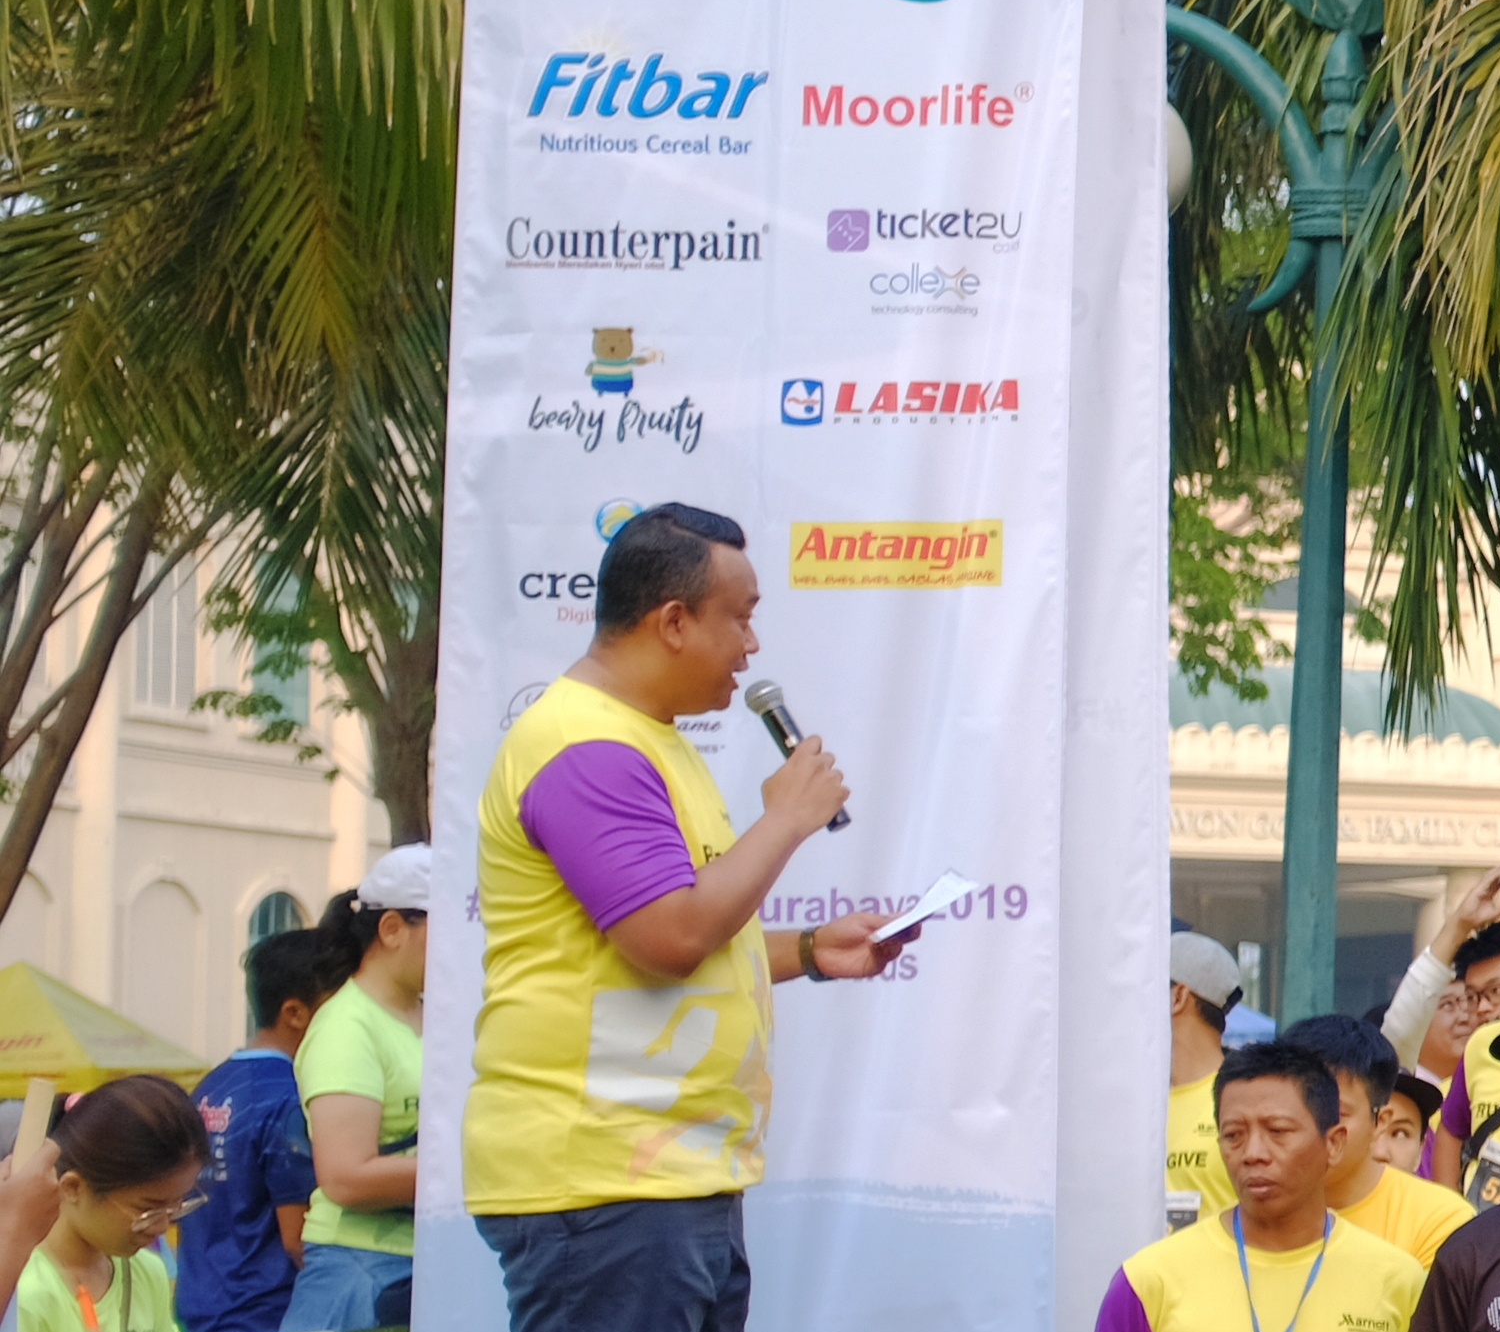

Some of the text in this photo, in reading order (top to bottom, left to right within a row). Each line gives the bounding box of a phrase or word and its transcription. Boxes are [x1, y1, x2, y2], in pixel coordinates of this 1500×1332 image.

[526, 51, 768, 120] Fitbar
[540, 133, 753, 155] Nutritious Cereal Bar
[834, 378, 1019, 416] LASIKA
[528, 395, 704, 455] beary fruity
[795, 525, 989, 571] Antangin
[1167, 1151, 1208, 1169] GIVE
